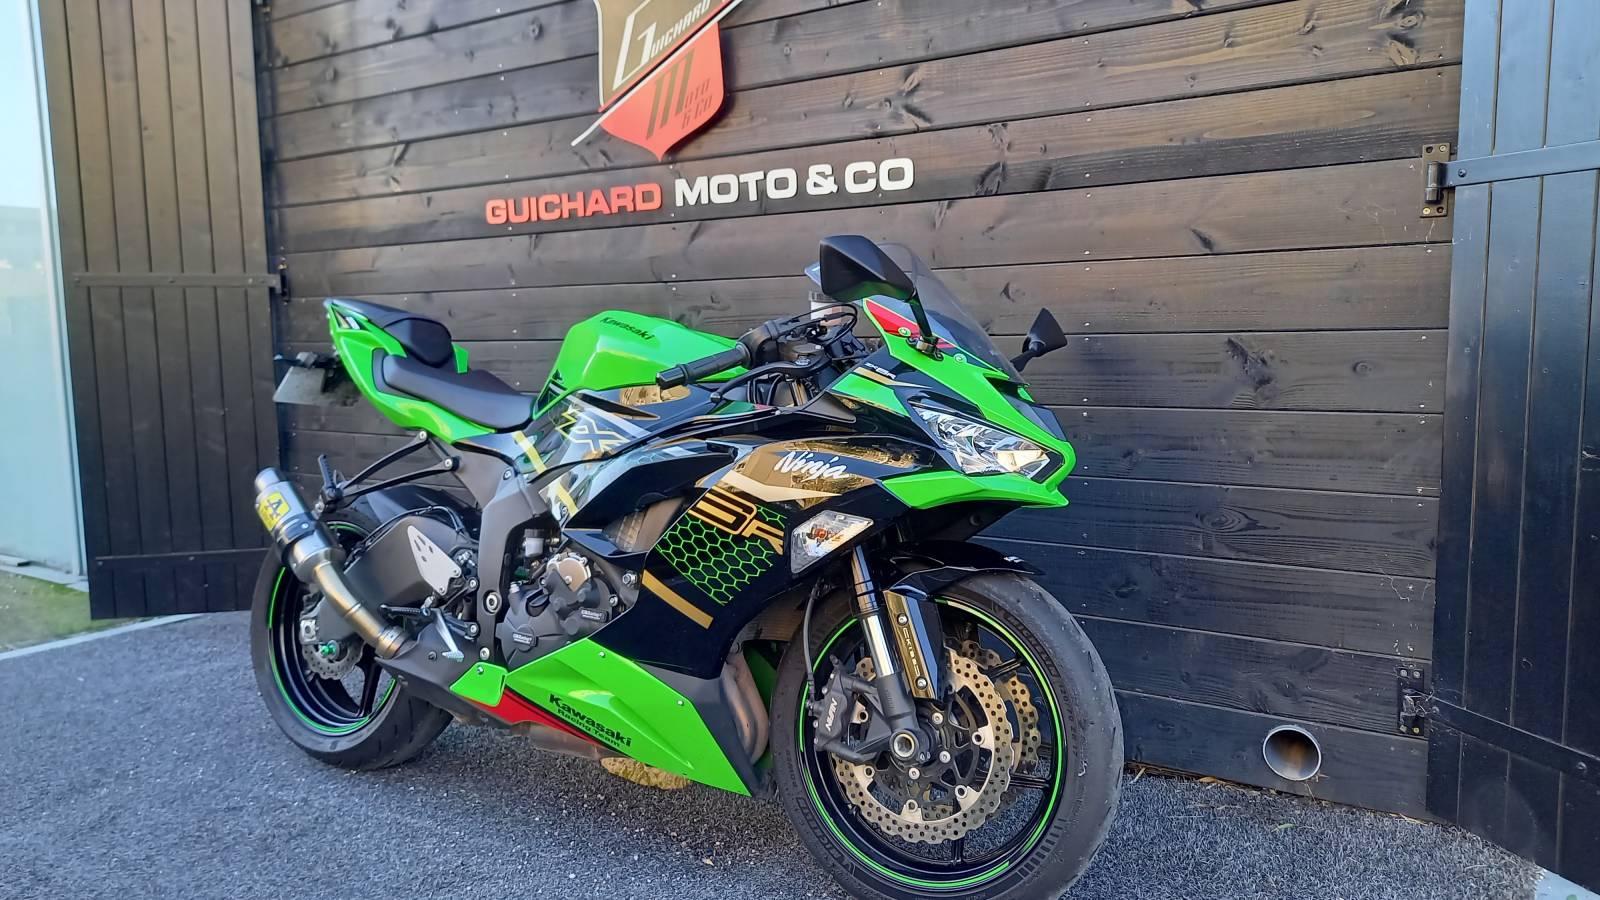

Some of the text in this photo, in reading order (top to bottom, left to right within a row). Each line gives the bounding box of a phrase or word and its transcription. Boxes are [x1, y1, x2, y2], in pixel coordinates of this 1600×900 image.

[485, 157, 915, 225] GUICHARD MOTO & CO
[600, 316, 656, 340] Kawasaki
[773, 450, 849, 483] Ninja
[549, 693, 632, 747] Kawasaki
[557, 708, 620, 747] Racing Team
